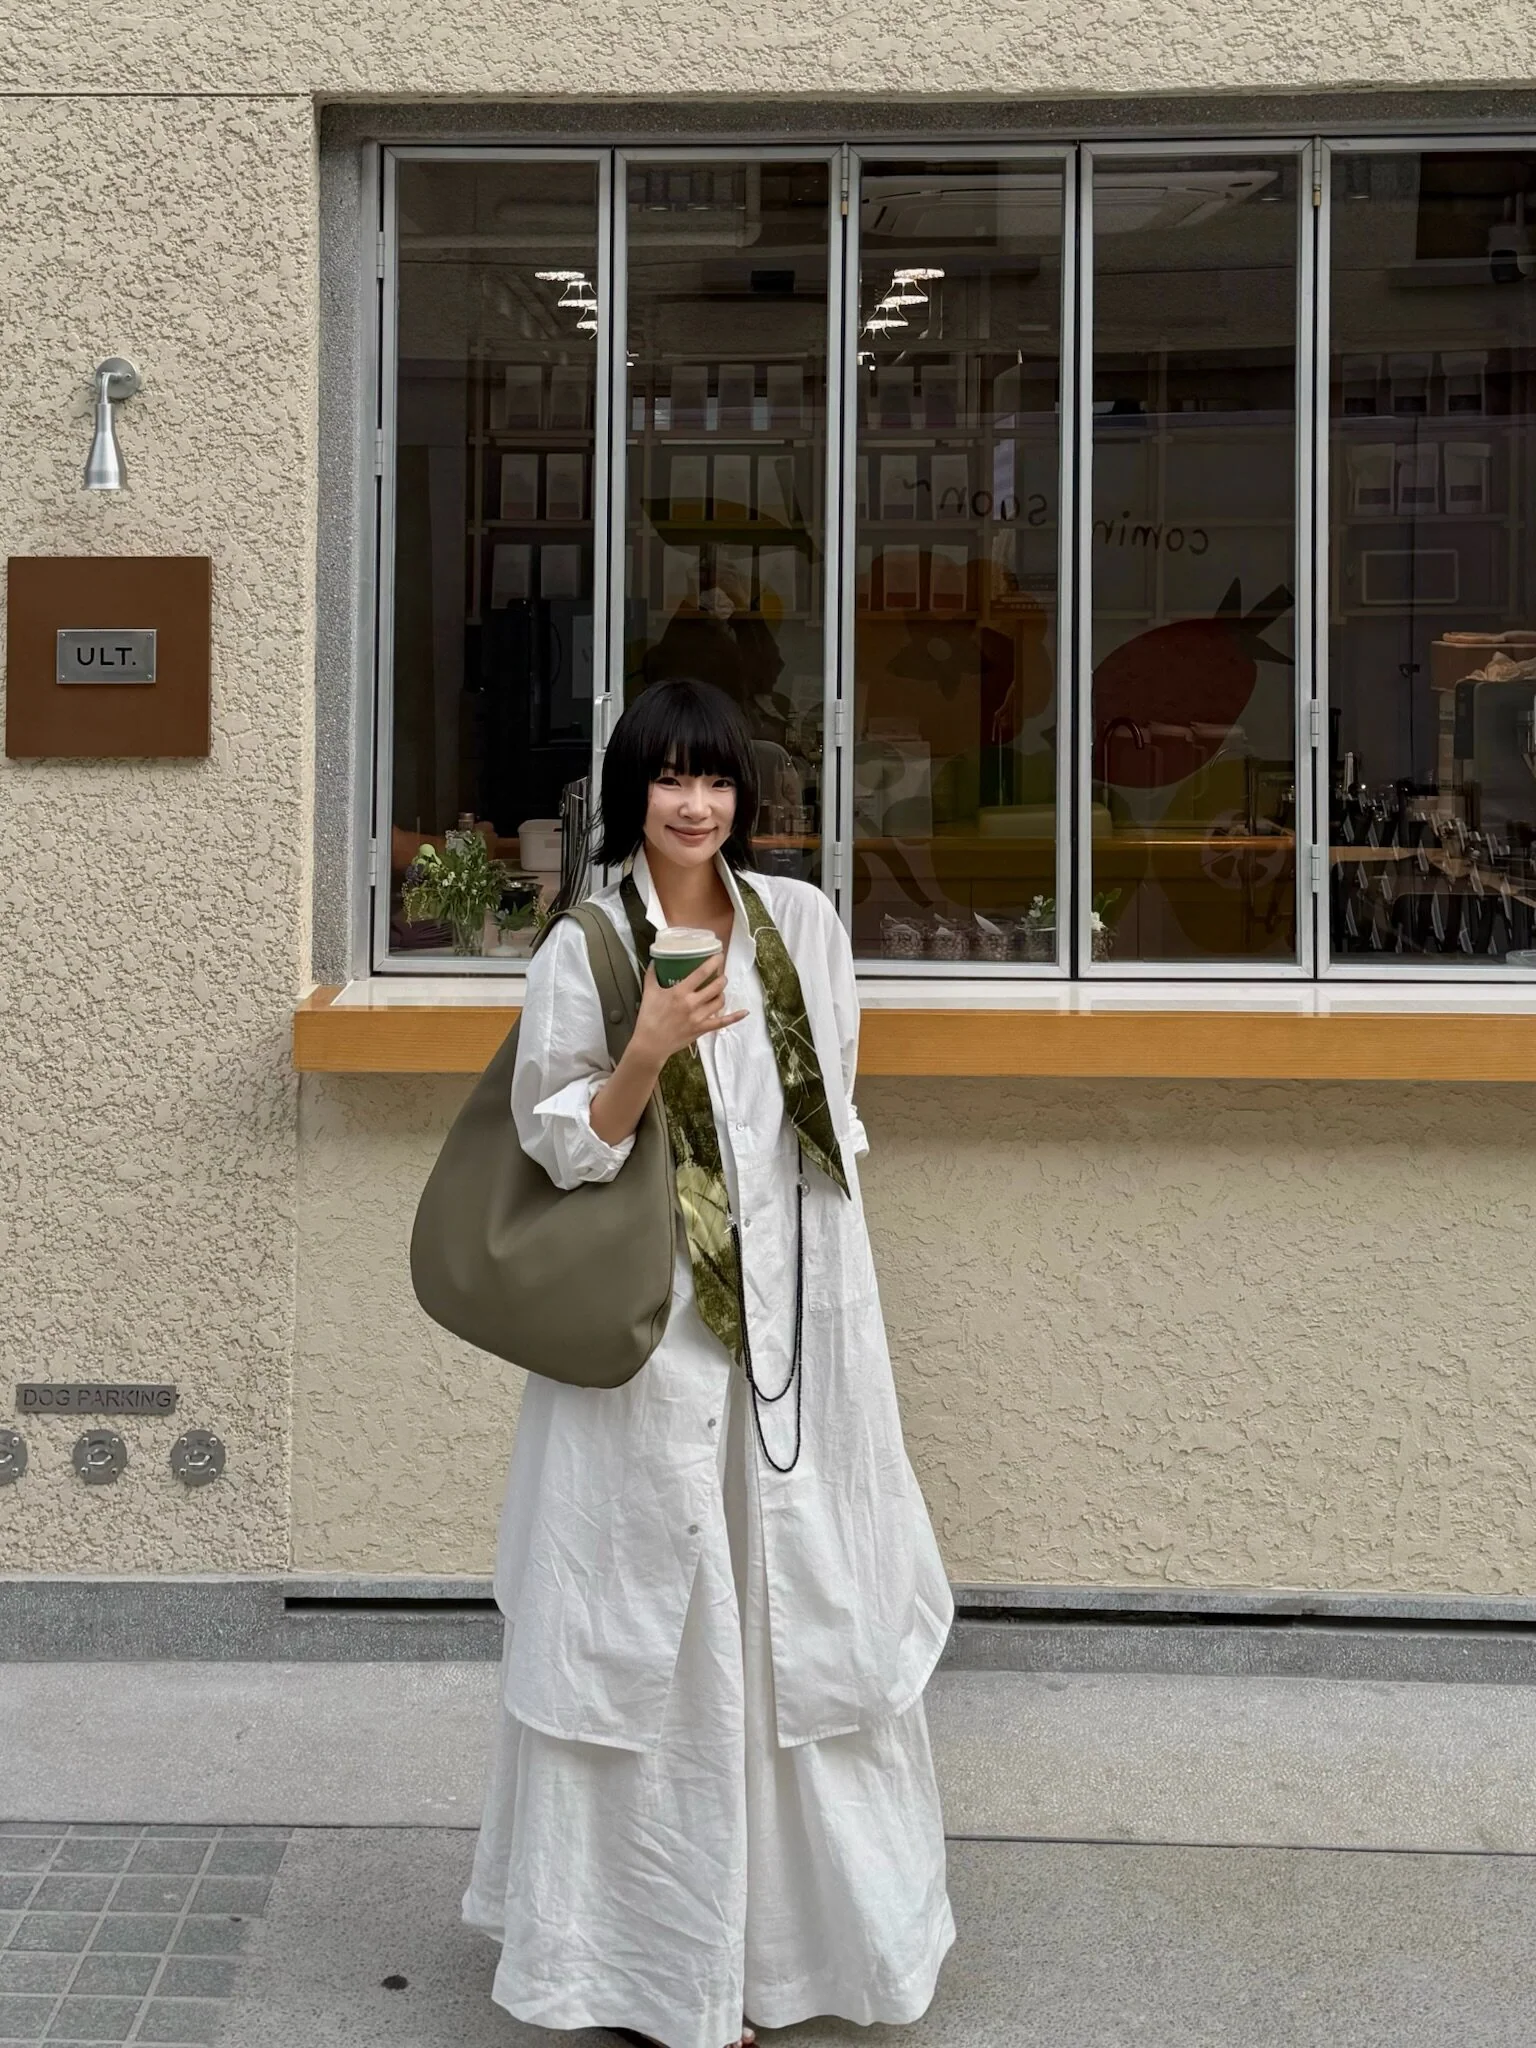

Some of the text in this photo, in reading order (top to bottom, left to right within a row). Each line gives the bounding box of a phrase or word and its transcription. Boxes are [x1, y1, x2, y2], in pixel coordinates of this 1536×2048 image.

[77, 647, 137, 666] ULT.
[23, 1388, 172, 1409] DOG PARKING
